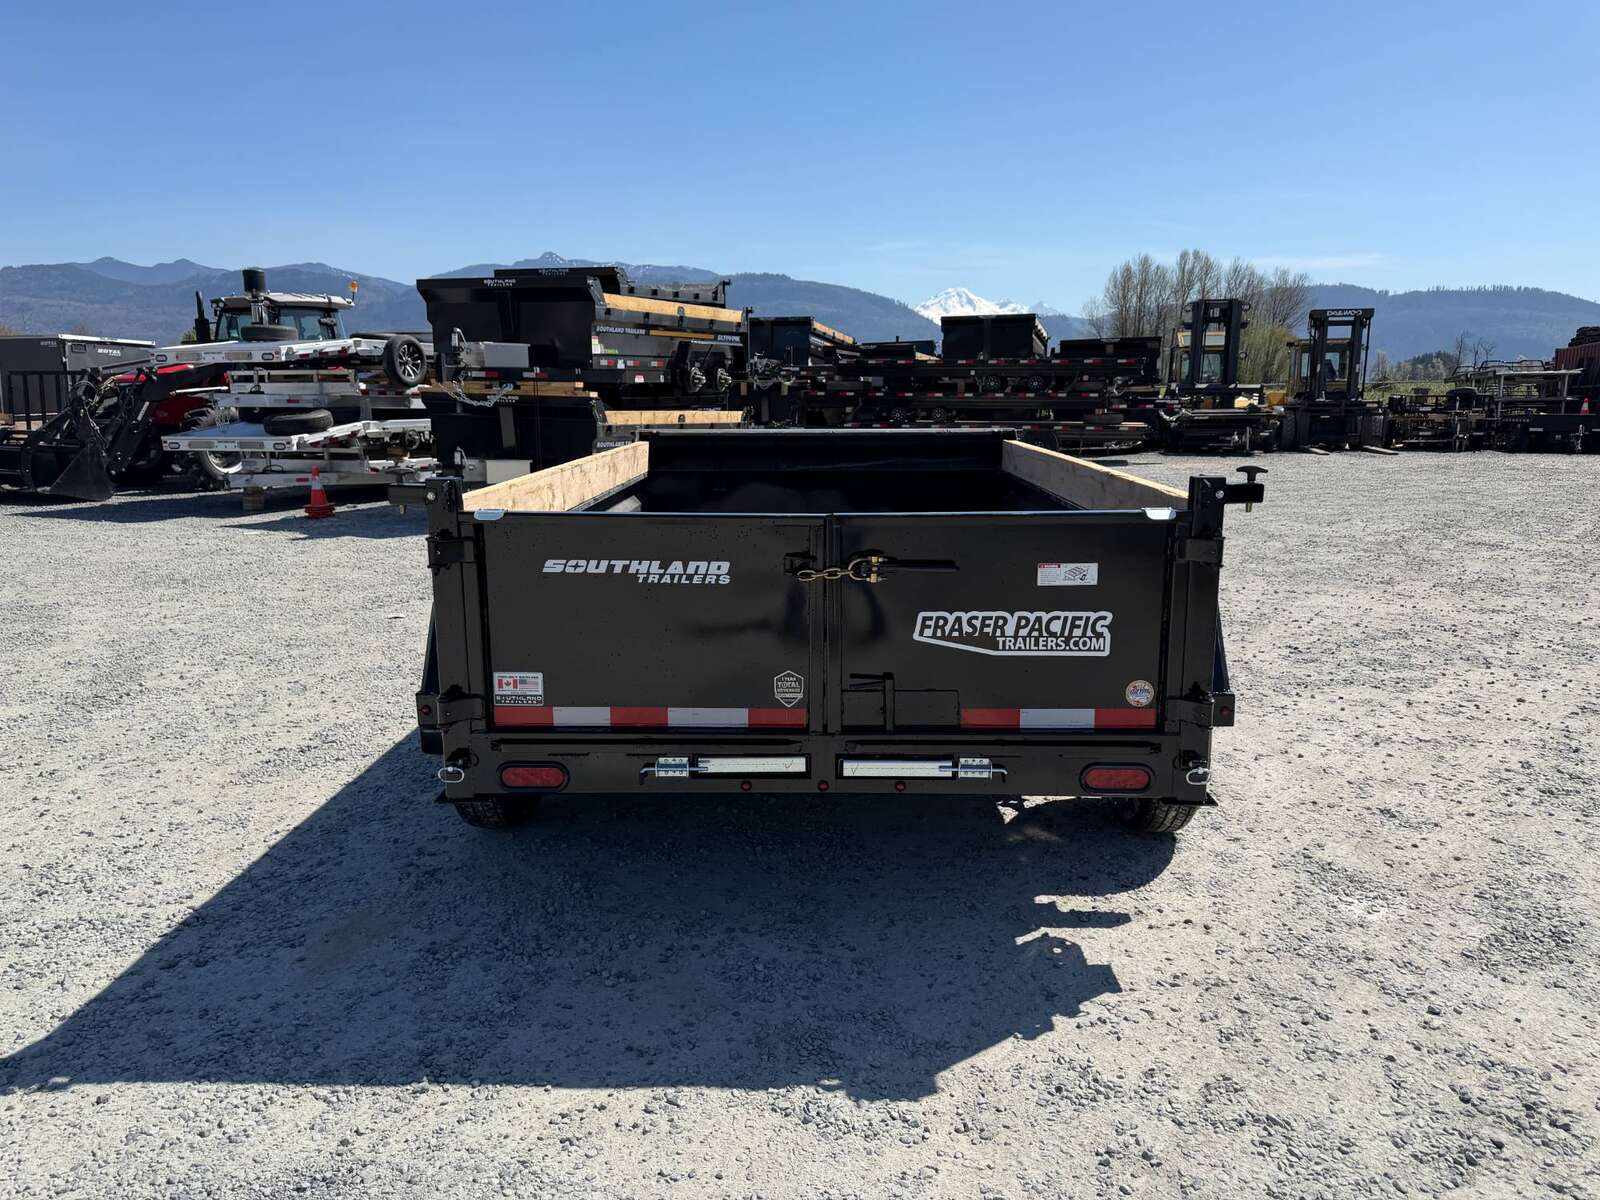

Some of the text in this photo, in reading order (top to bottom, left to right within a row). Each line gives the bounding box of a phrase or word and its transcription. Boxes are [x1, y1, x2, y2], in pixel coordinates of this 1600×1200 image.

[1327, 309, 1362, 317] DAEWOO
[596, 325, 646, 335] SOUTHLAND TRAILERS
[542, 559, 731, 575] SOUTHLAND
[636, 575, 731, 585] TRAILERS
[918, 613, 1109, 637] FRASER PACIFIC
[996, 637, 1105, 651] TRAILERS.COM
